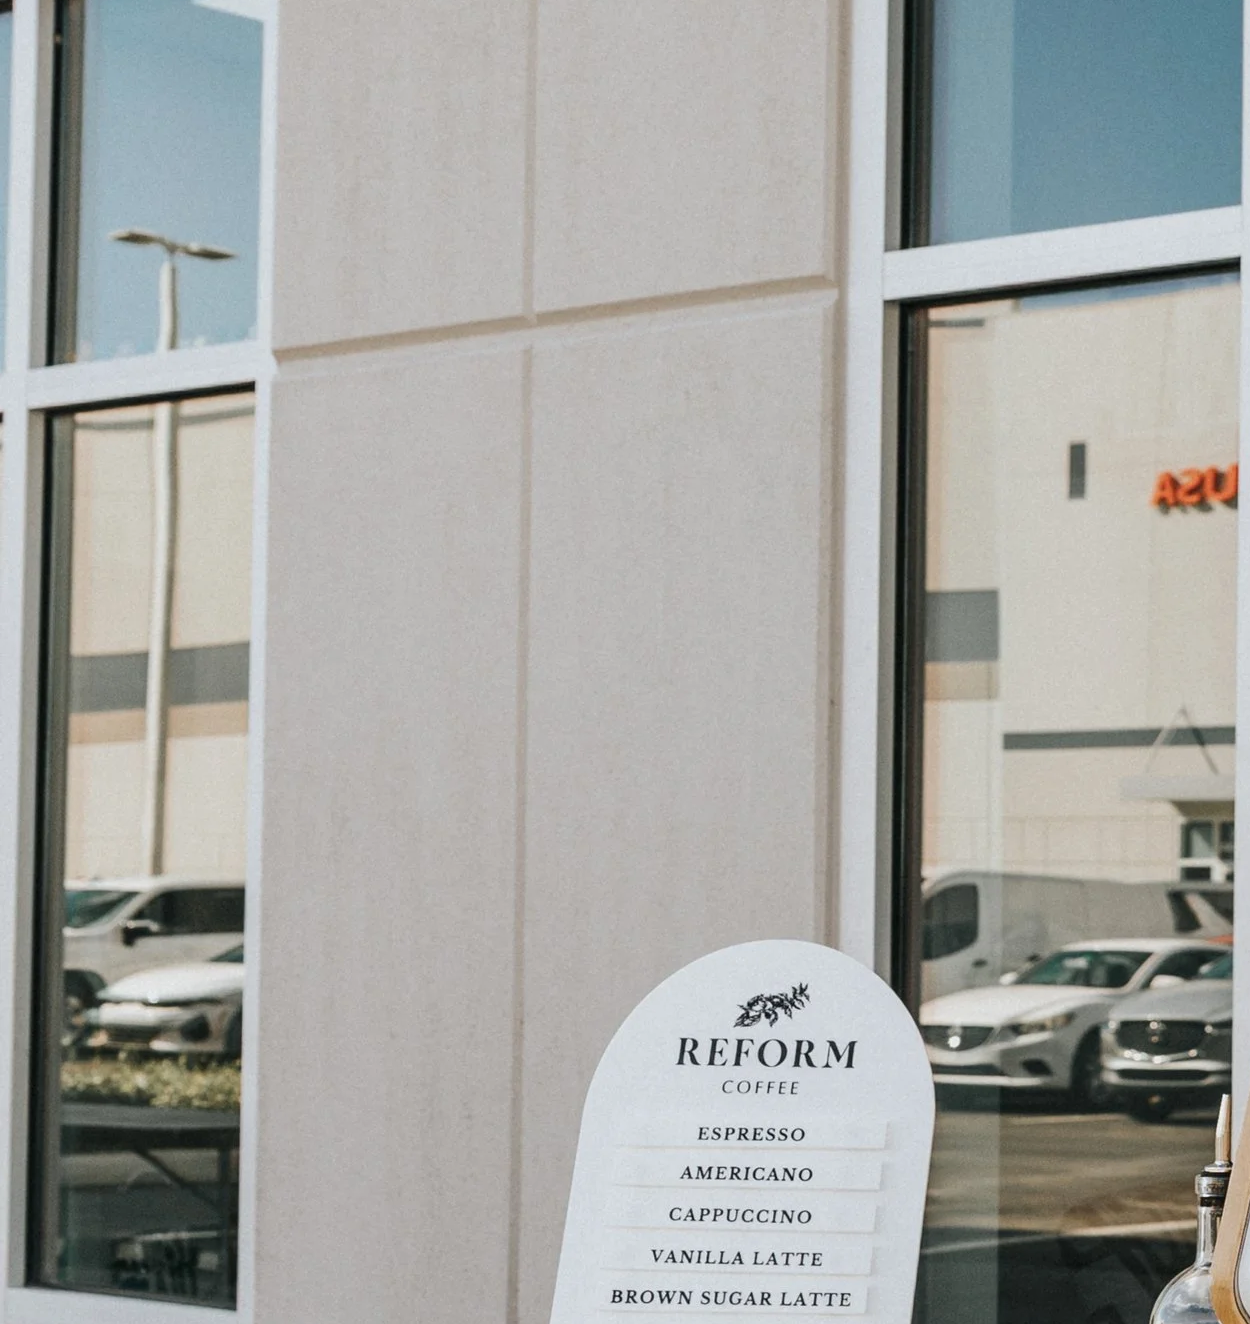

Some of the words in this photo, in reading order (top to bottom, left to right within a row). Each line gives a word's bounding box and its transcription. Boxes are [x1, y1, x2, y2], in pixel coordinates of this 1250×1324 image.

[677, 1037, 857, 1069] REFORM
[721, 1079, 800, 1095] COFFEE
[698, 1127, 806, 1142] ESPRESSO
[680, 1165, 813, 1182] AMERICANO
[669, 1207, 812, 1224] CAPPUCCINO
[651, 1249, 745, 1265] VANILLA
[753, 1251, 823, 1267] LATTE
[611, 1289, 693, 1305] BROWN
[700, 1290, 772, 1306] SUGAR
[780, 1292, 851, 1307] LATTE
